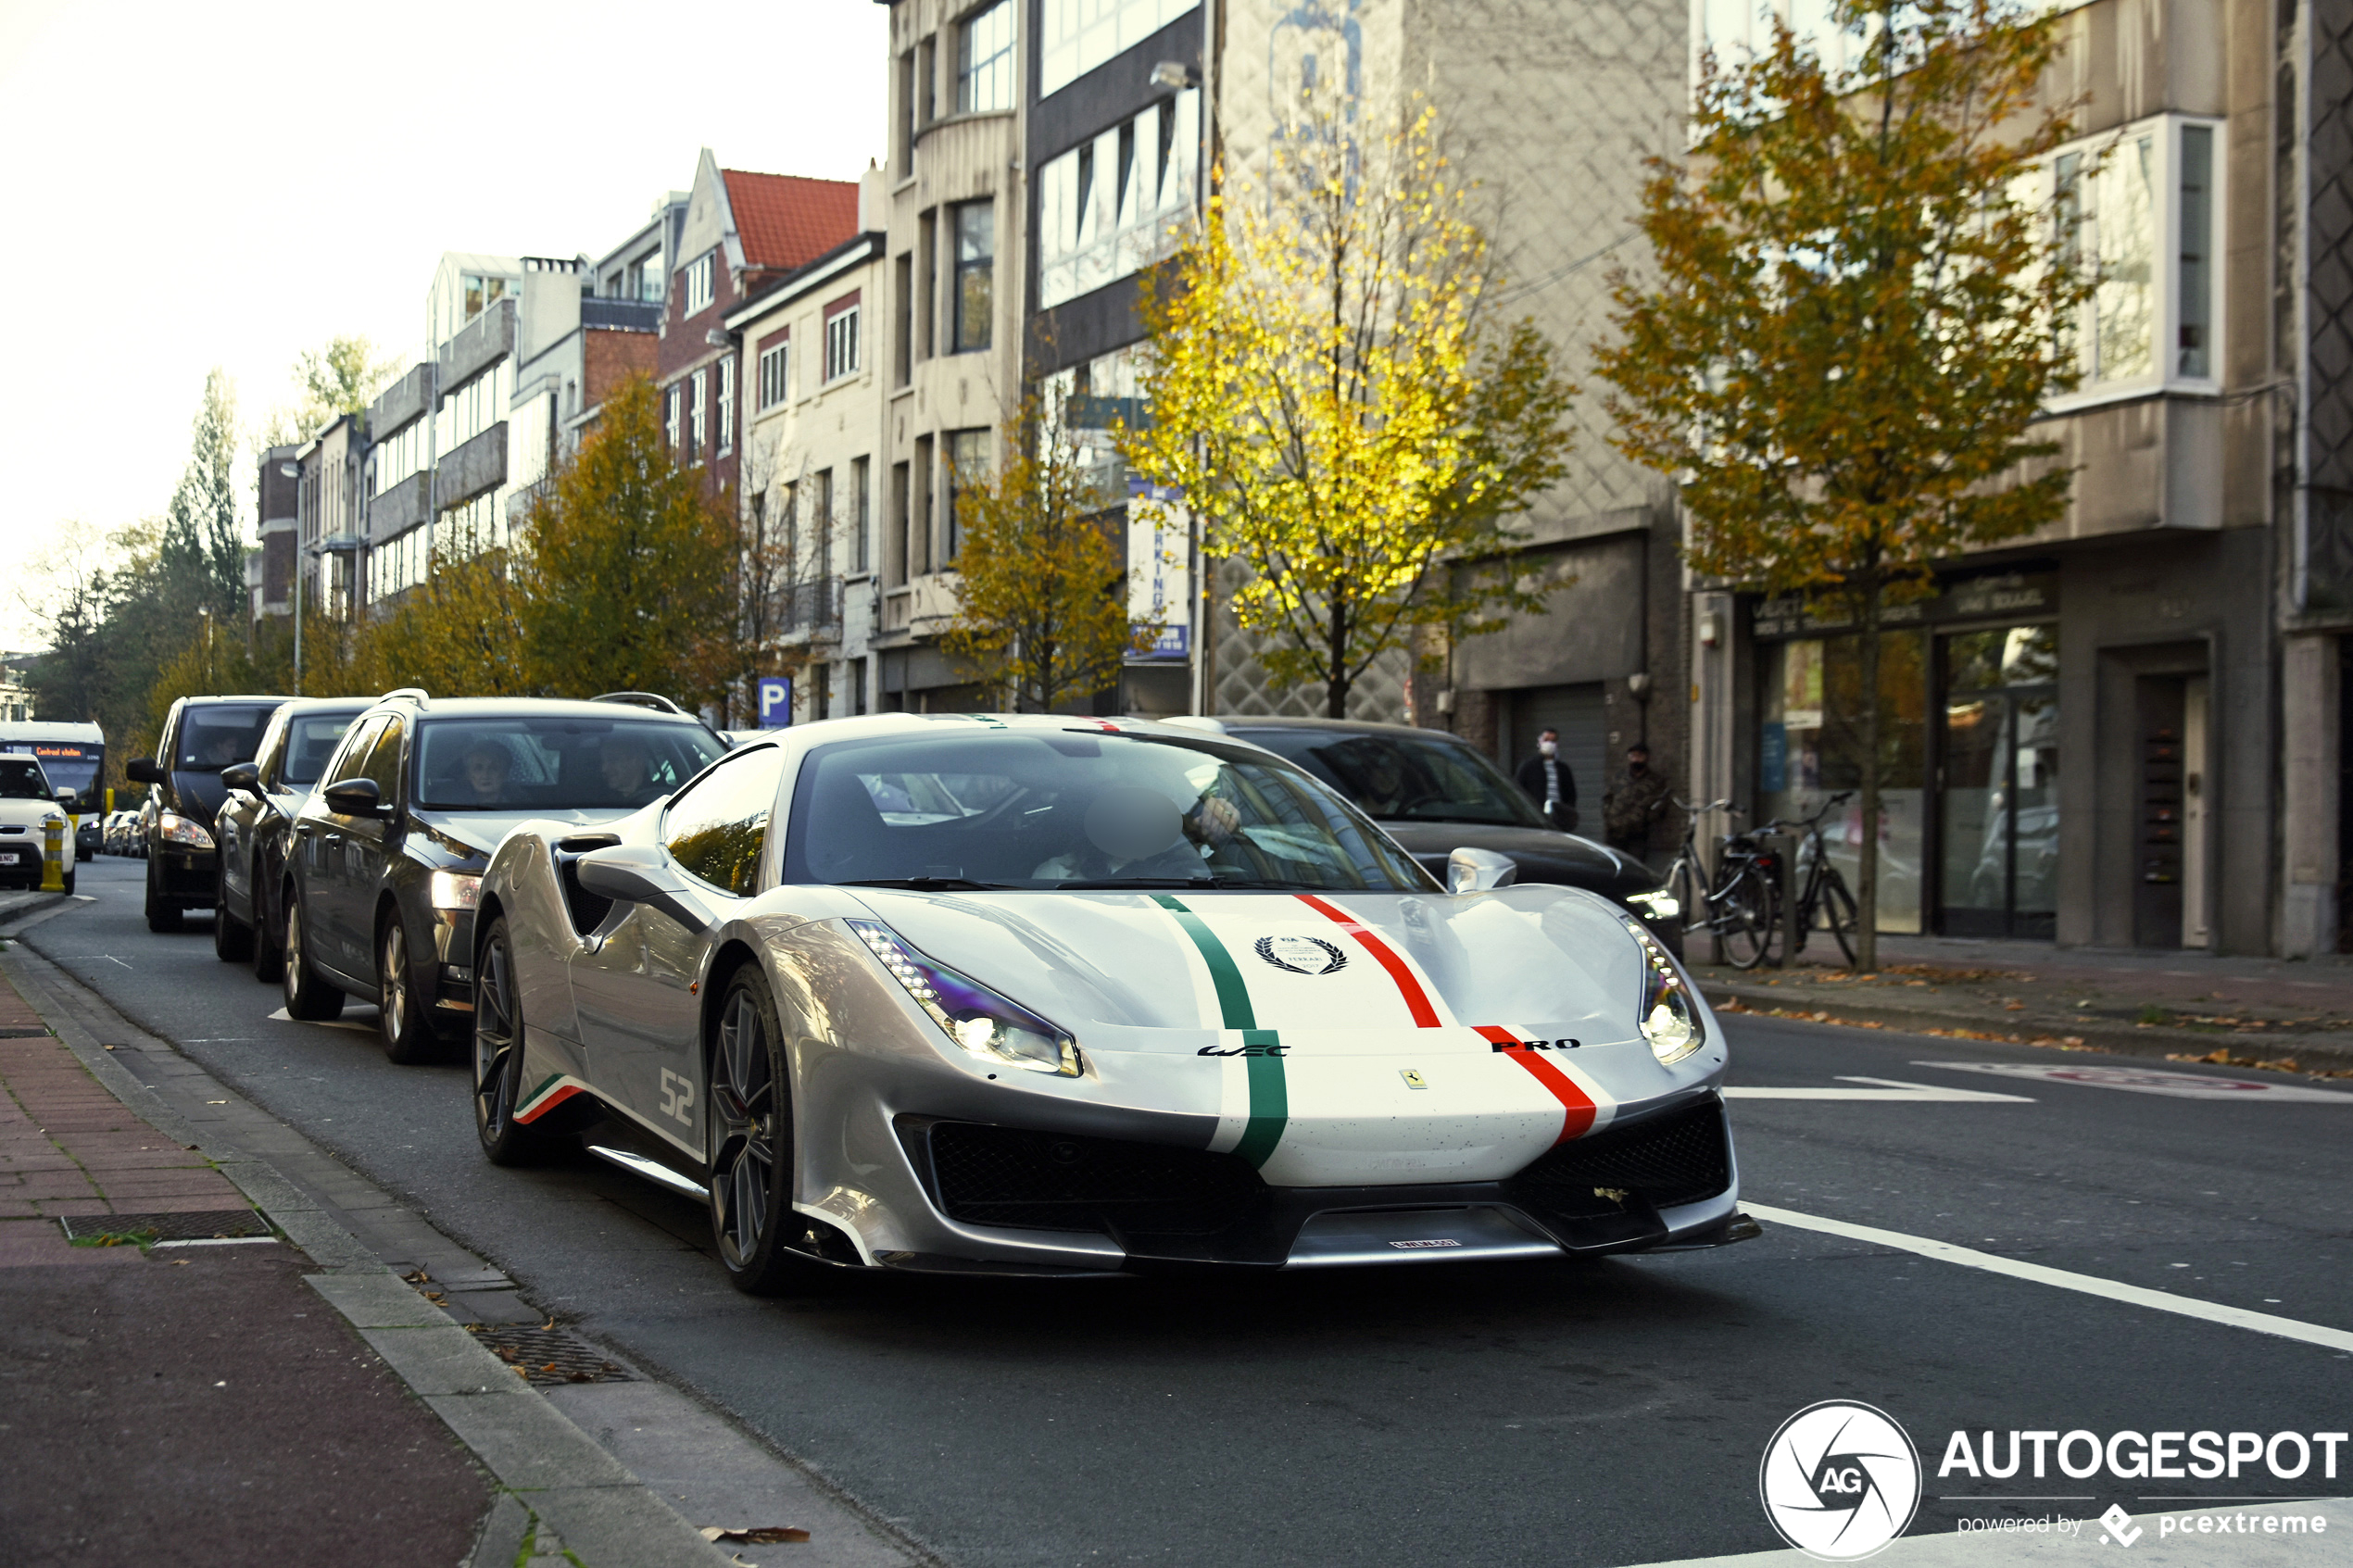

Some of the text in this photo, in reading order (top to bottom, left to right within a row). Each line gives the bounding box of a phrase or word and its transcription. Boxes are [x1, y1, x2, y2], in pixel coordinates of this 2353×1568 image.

[762, 684, 786, 717] P
[61, 748, 82, 757] station
[1197, 1045, 1291, 1057] WEC
[1491, 1039, 1580, 1053] PRO
[660, 1066, 695, 1127] 52
